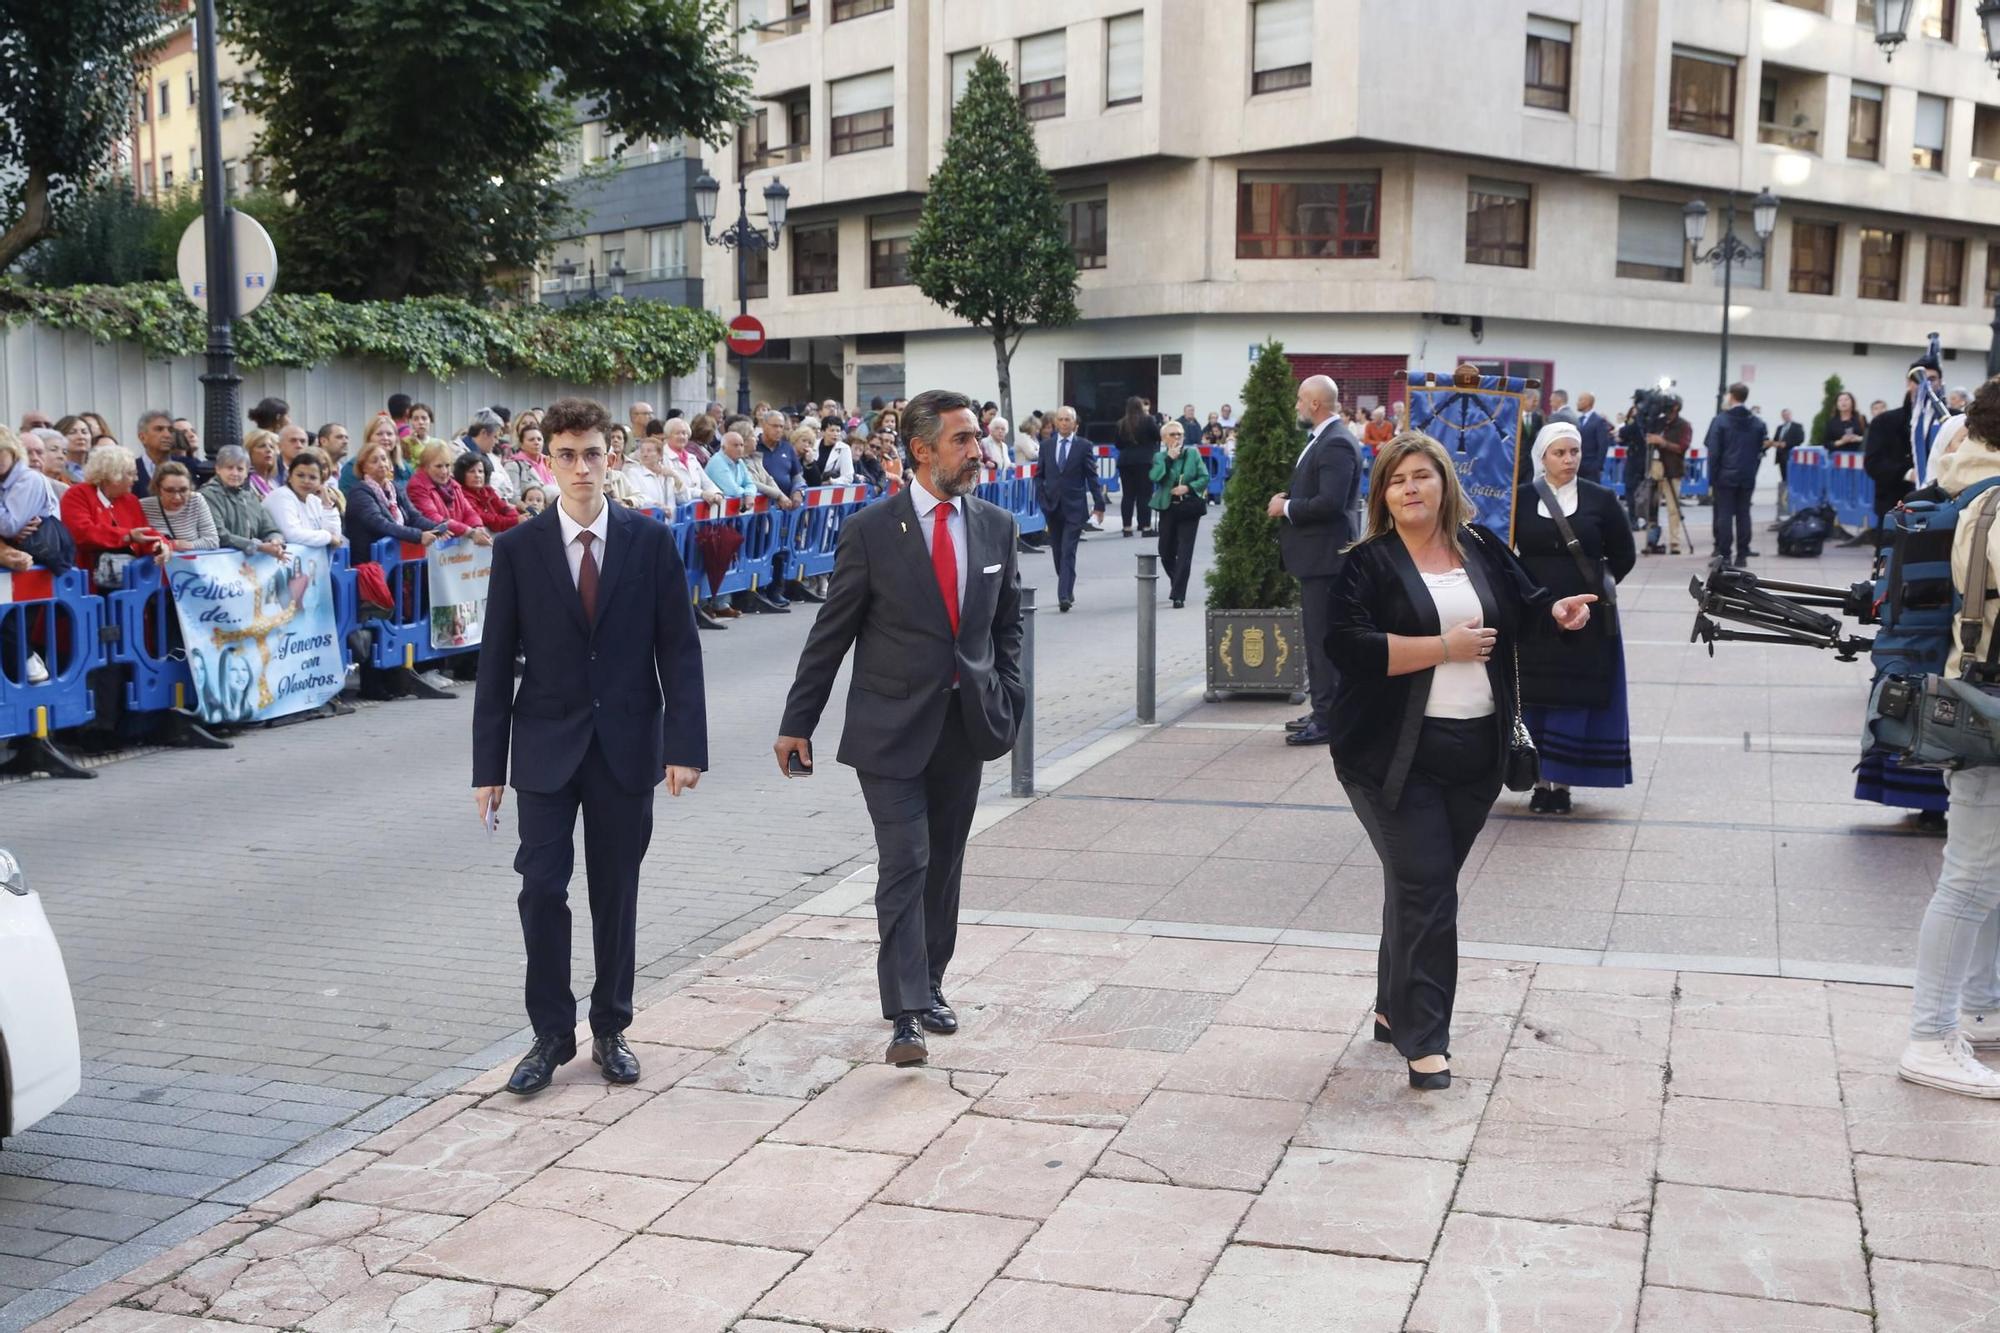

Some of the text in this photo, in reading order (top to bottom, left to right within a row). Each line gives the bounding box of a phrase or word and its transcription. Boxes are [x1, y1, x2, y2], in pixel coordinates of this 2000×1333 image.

[1453, 457, 1479, 476] eal
[170, 569, 245, 601] Felices
[199, 605, 242, 624] de...
[277, 632, 333, 660] Teneros
[300, 655, 321, 671] con
[277, 673, 339, 700] Nosotros.
